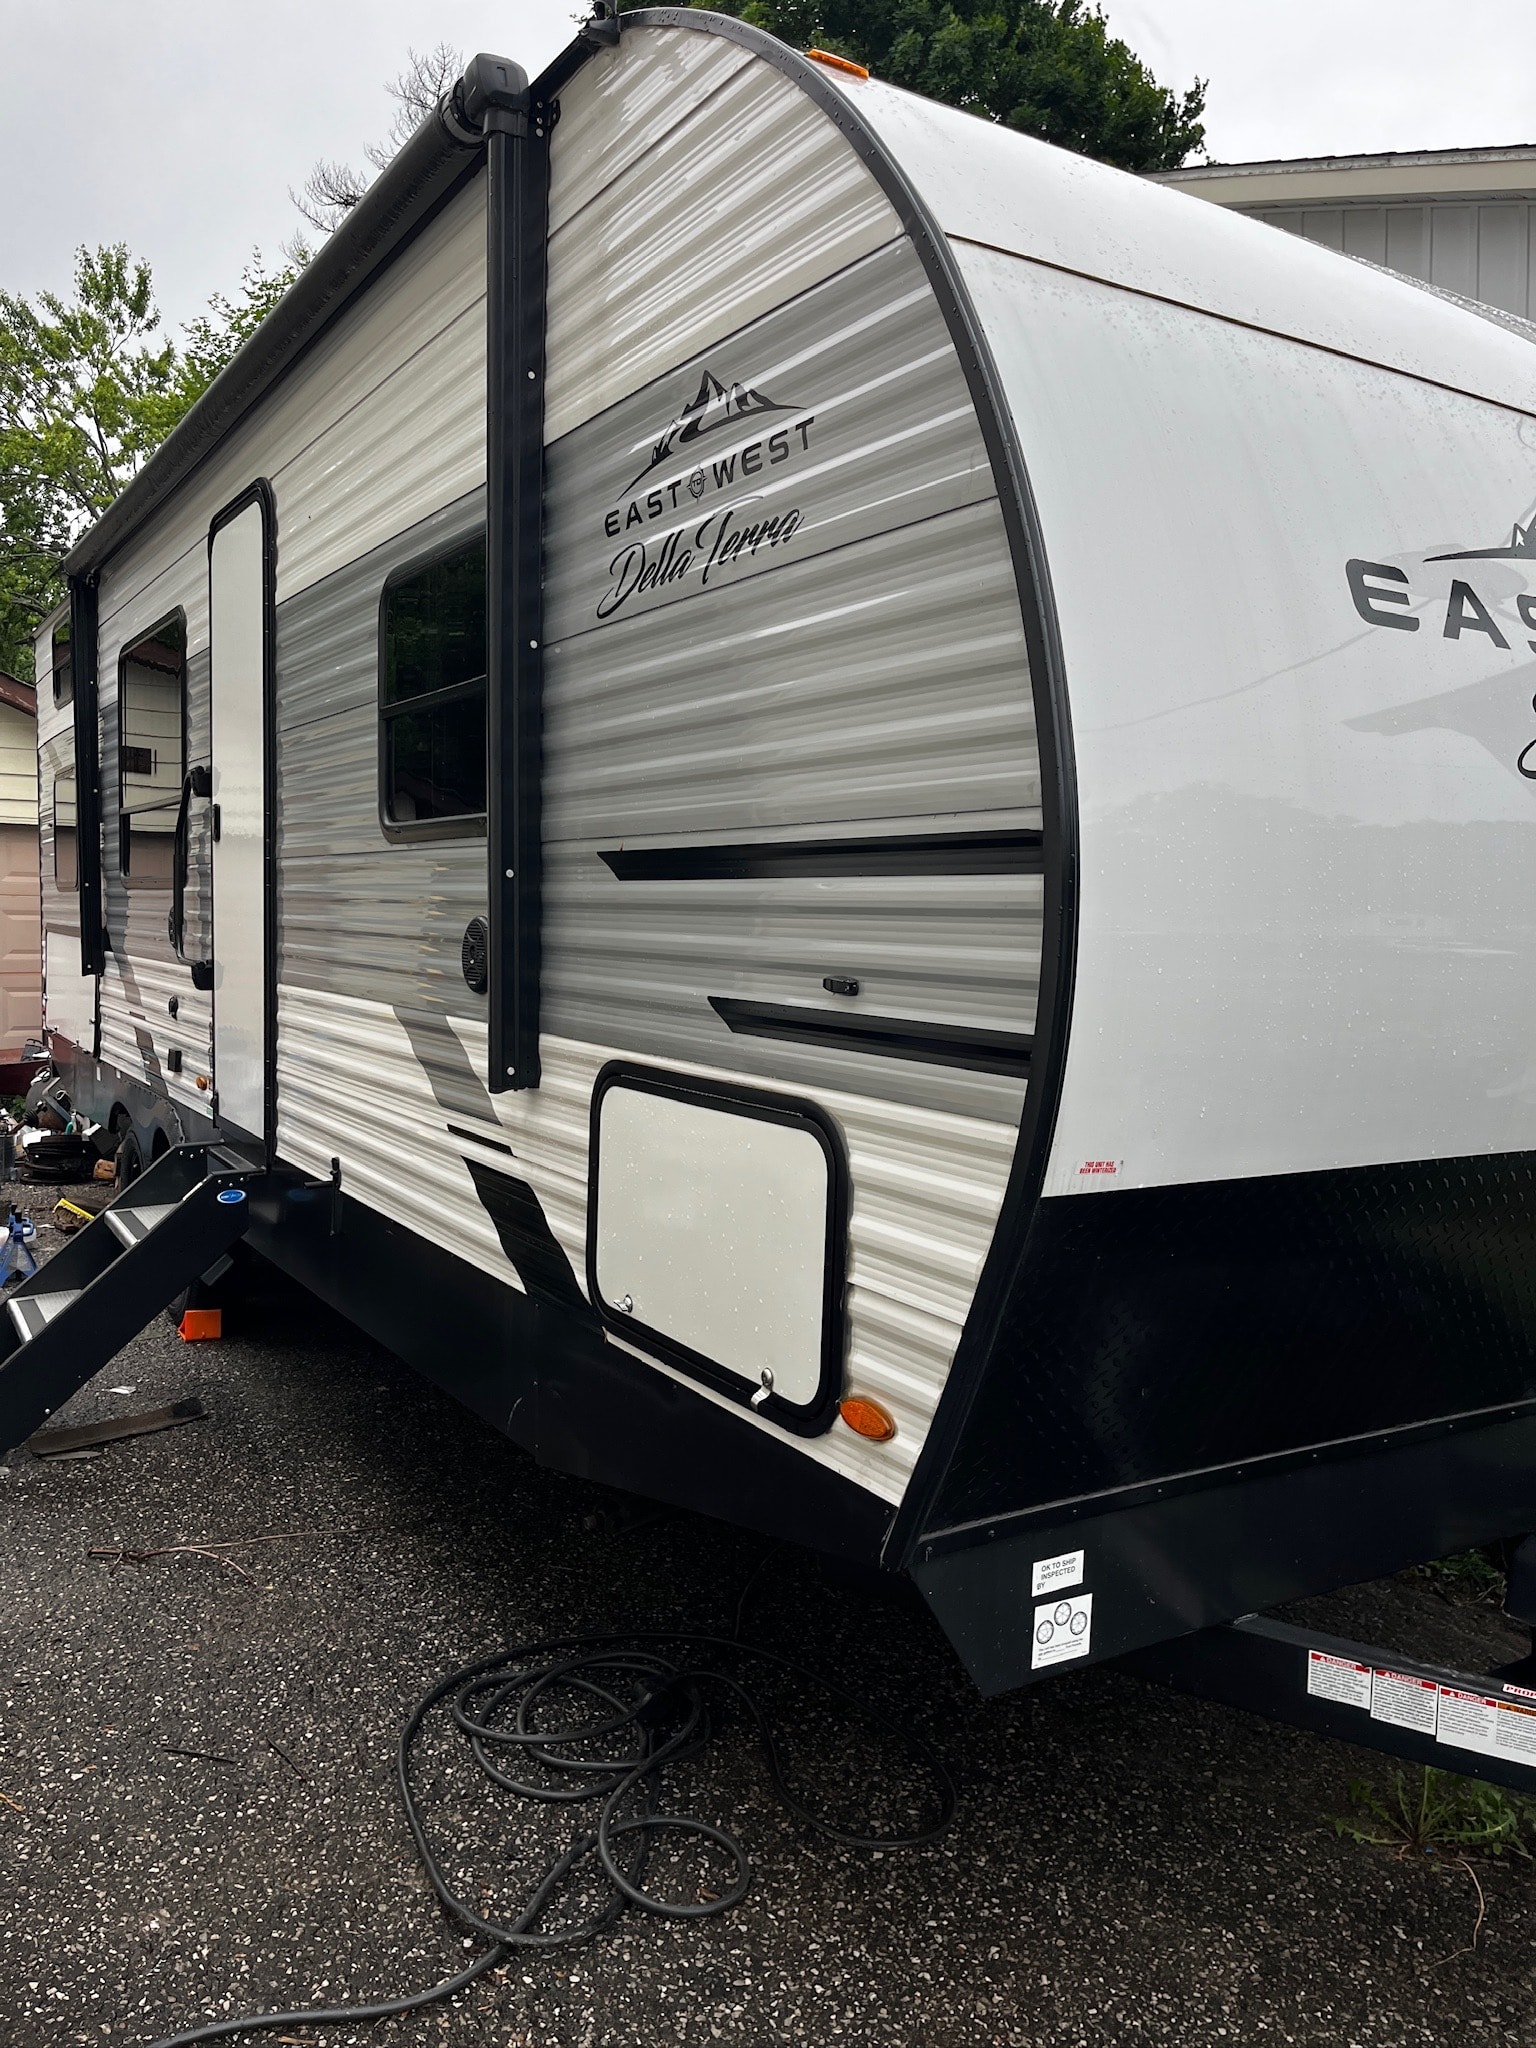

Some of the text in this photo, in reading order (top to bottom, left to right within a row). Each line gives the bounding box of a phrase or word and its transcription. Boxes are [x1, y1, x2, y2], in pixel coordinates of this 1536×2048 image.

[604, 479, 682, 538] EAST
[712, 416, 815, 488] WEST
[597, 496, 805, 619] Della Terra
[1041, 1557, 1077, 1572] OK TO SHIP
[1040, 1565, 1076, 1580] INSPECTED
[1036, 1582, 1046, 1590] BY
[1326, 1657, 1357, 1670] DANGER
[1391, 1673, 1423, 1686] DANGER
[1457, 1692, 1487, 1705] DANGER
